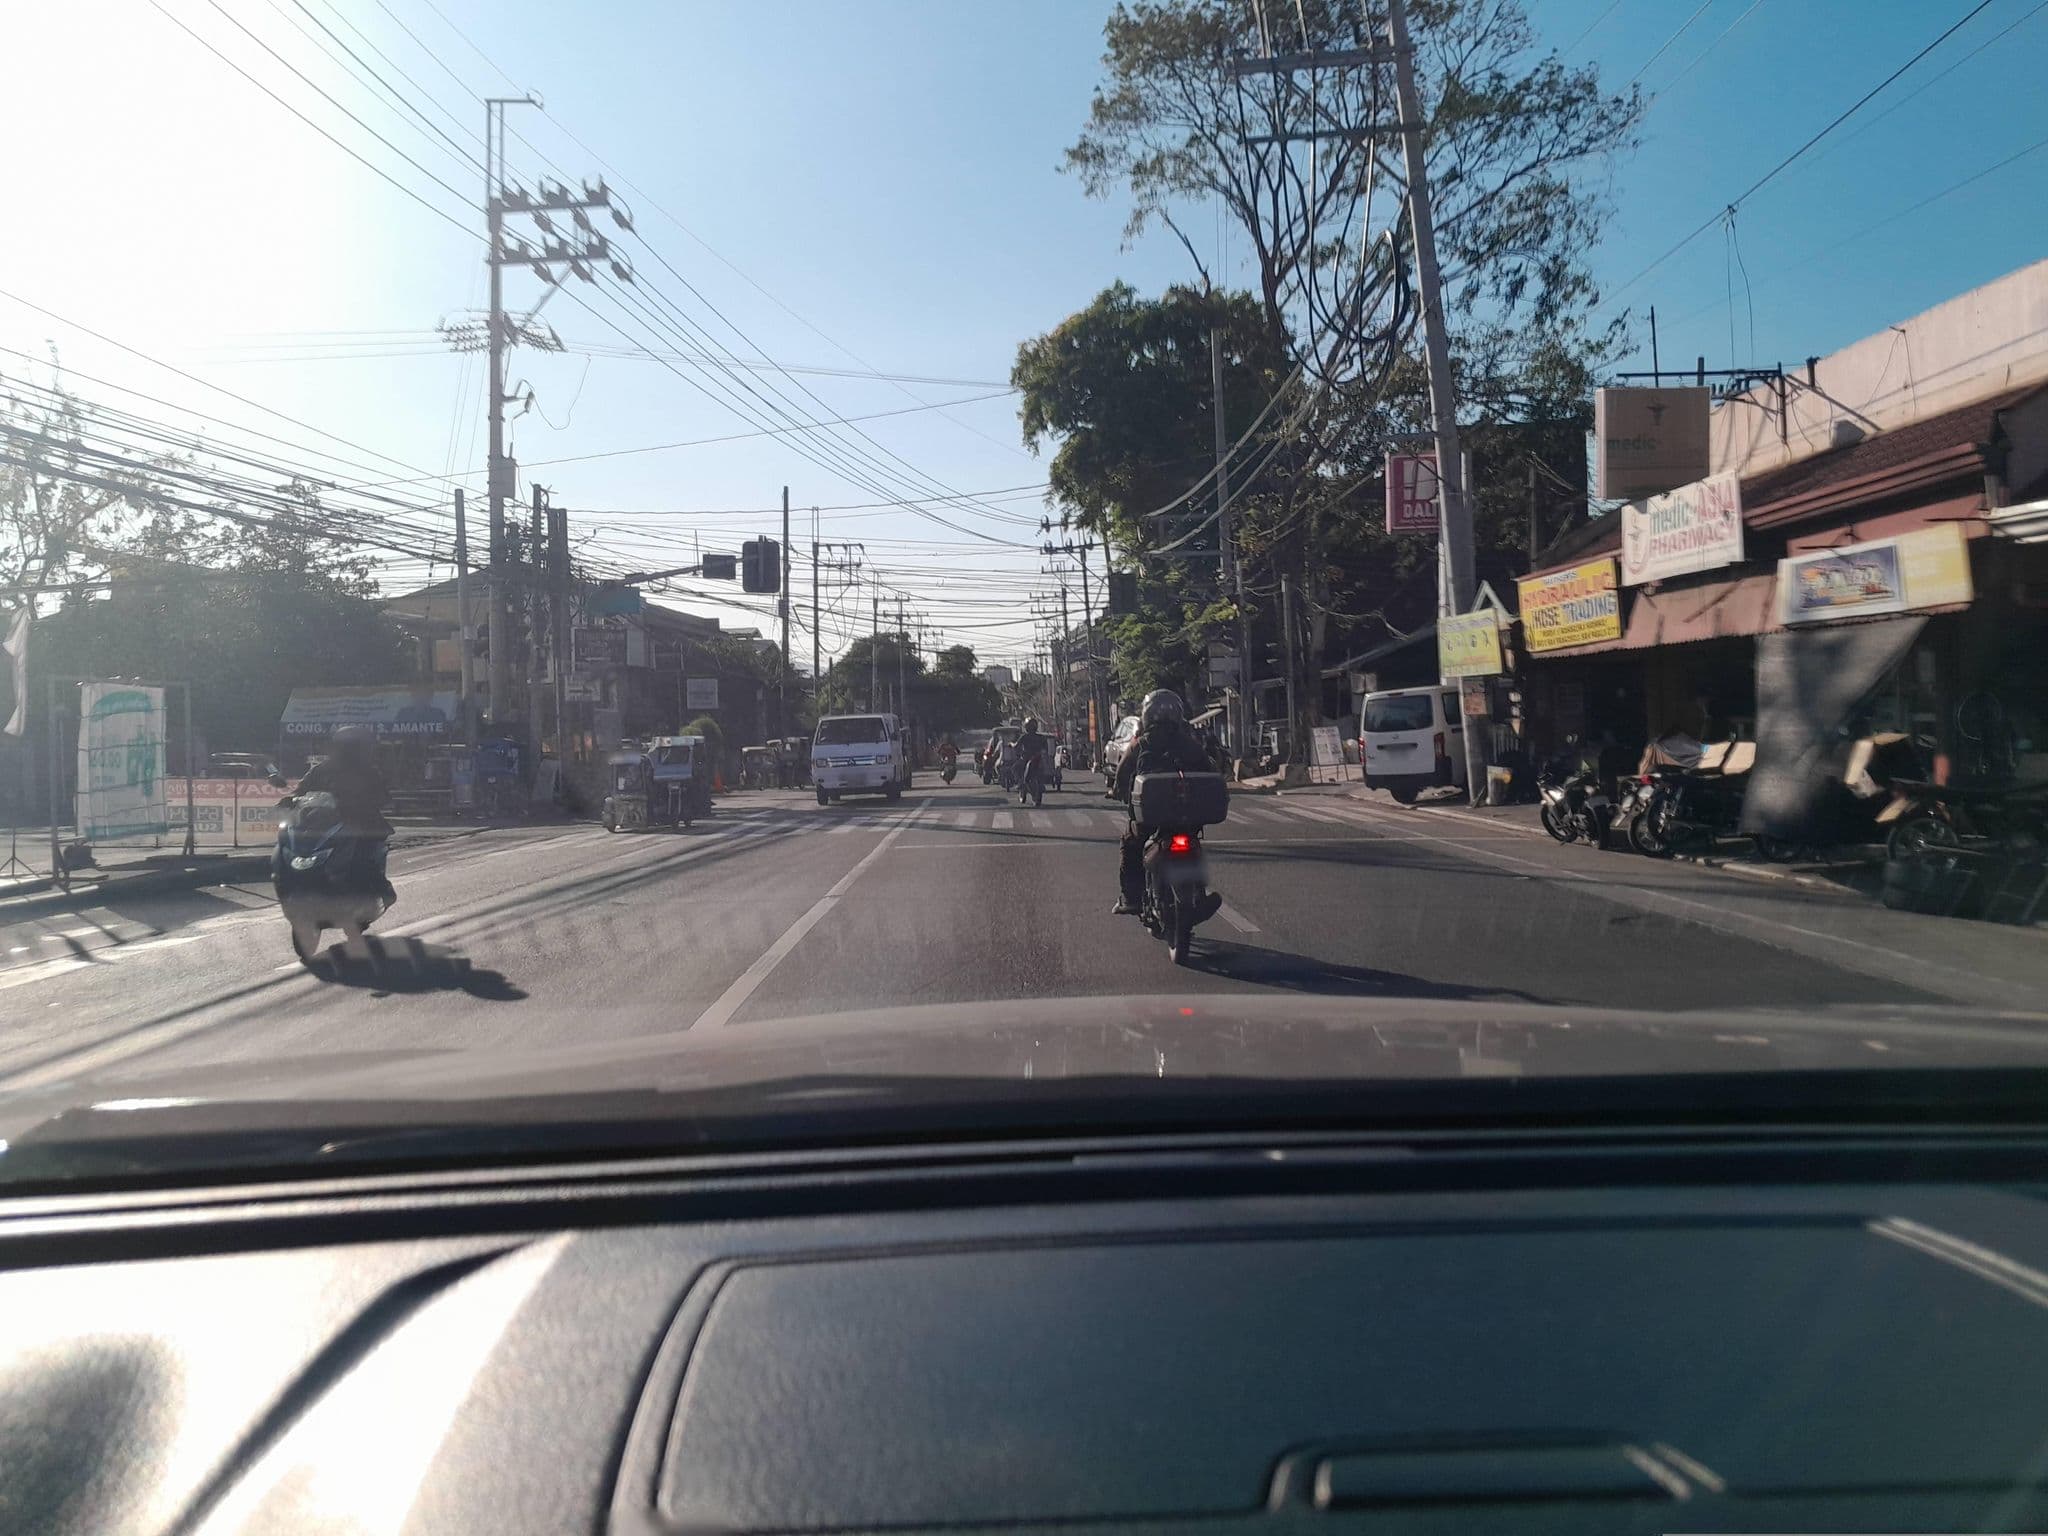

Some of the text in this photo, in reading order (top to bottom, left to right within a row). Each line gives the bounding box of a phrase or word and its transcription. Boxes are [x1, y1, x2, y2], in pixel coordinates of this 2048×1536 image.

[1532, 604, 1561, 629] HOSE
[1561, 591, 1617, 623] TRADING
[286, 722, 326, 735] CONG.
[393, 721, 445, 735] AMANTE
